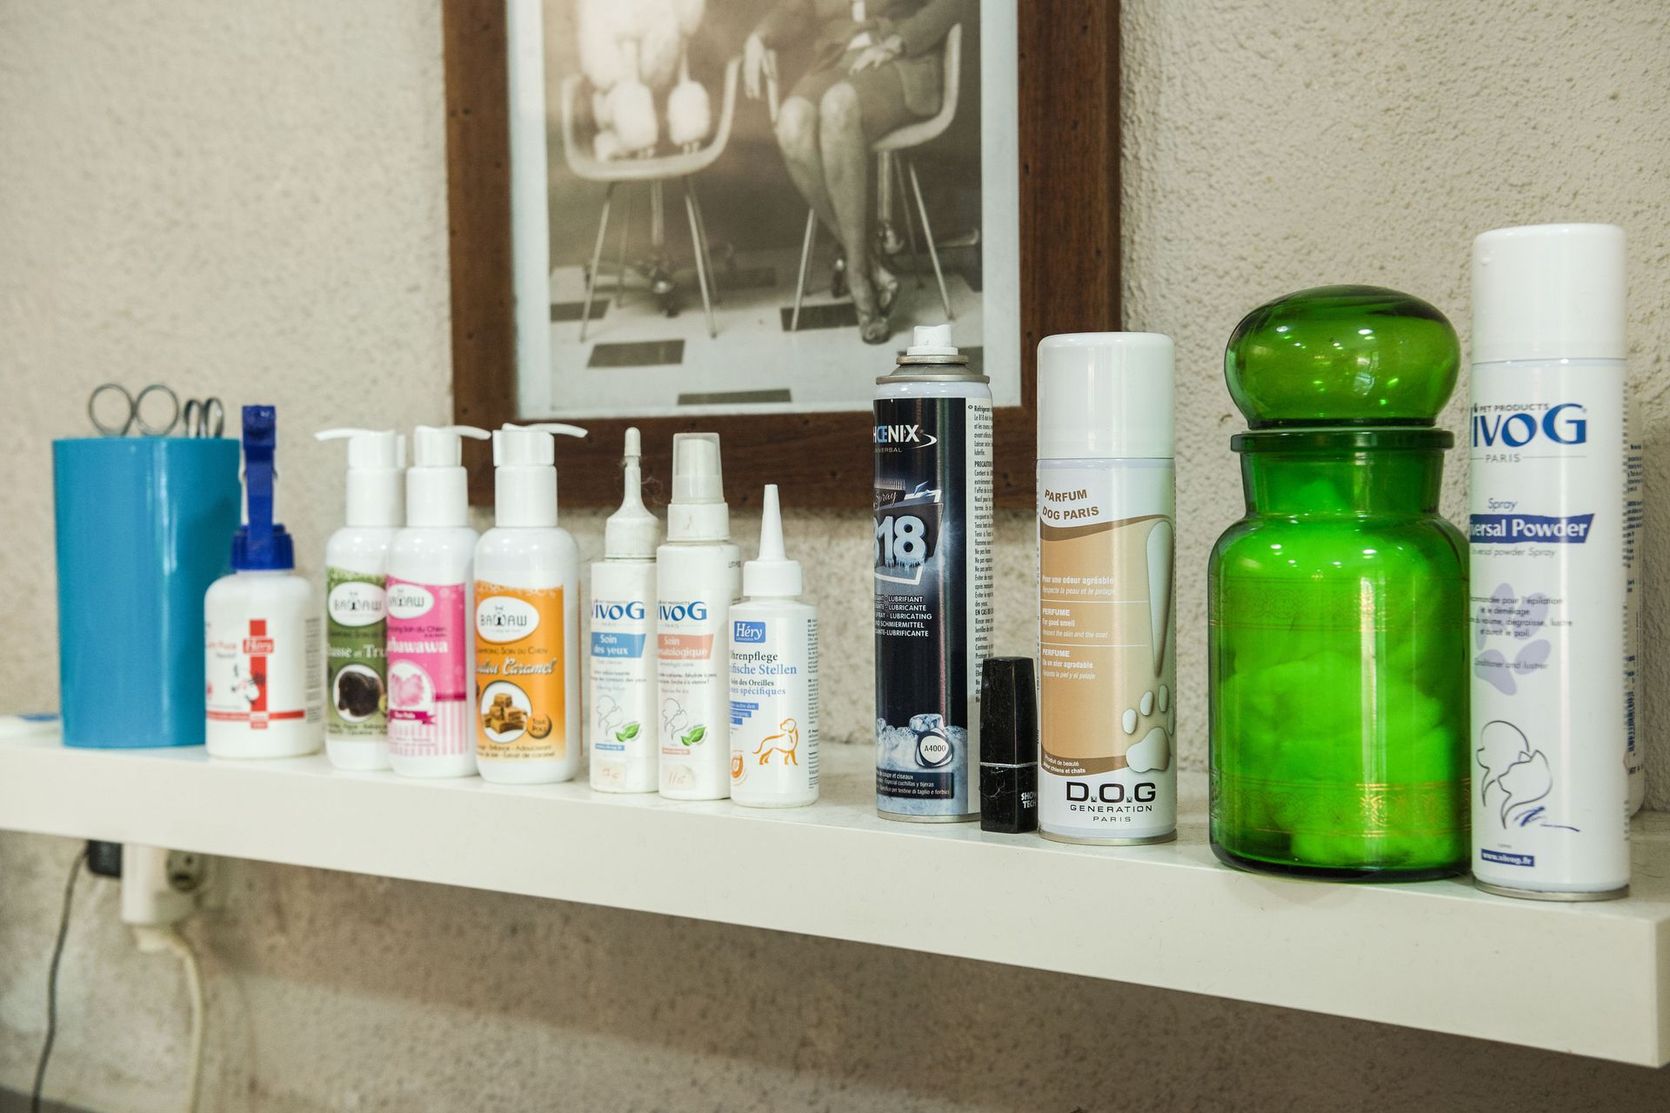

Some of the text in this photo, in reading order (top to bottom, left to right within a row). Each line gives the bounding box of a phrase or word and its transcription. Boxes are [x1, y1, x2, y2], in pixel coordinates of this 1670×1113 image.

[1494, 403, 1550, 412] PRODUCTS
[1473, 403, 1587, 448] IVOG
[1484, 454, 1521, 463] PARIS
[1044, 489, 1087, 502] PARFUM
[1488, 498, 1518, 512] Spray
[1042, 505, 1099, 520] DOG PARIS
[1511, 518, 1588, 537] Powder
[594, 601, 645, 620] IVOG
[659, 601, 707, 621] IVOG
[759, 663, 797, 675] Stellen
[1070, 804, 1153, 813] GENERATION
